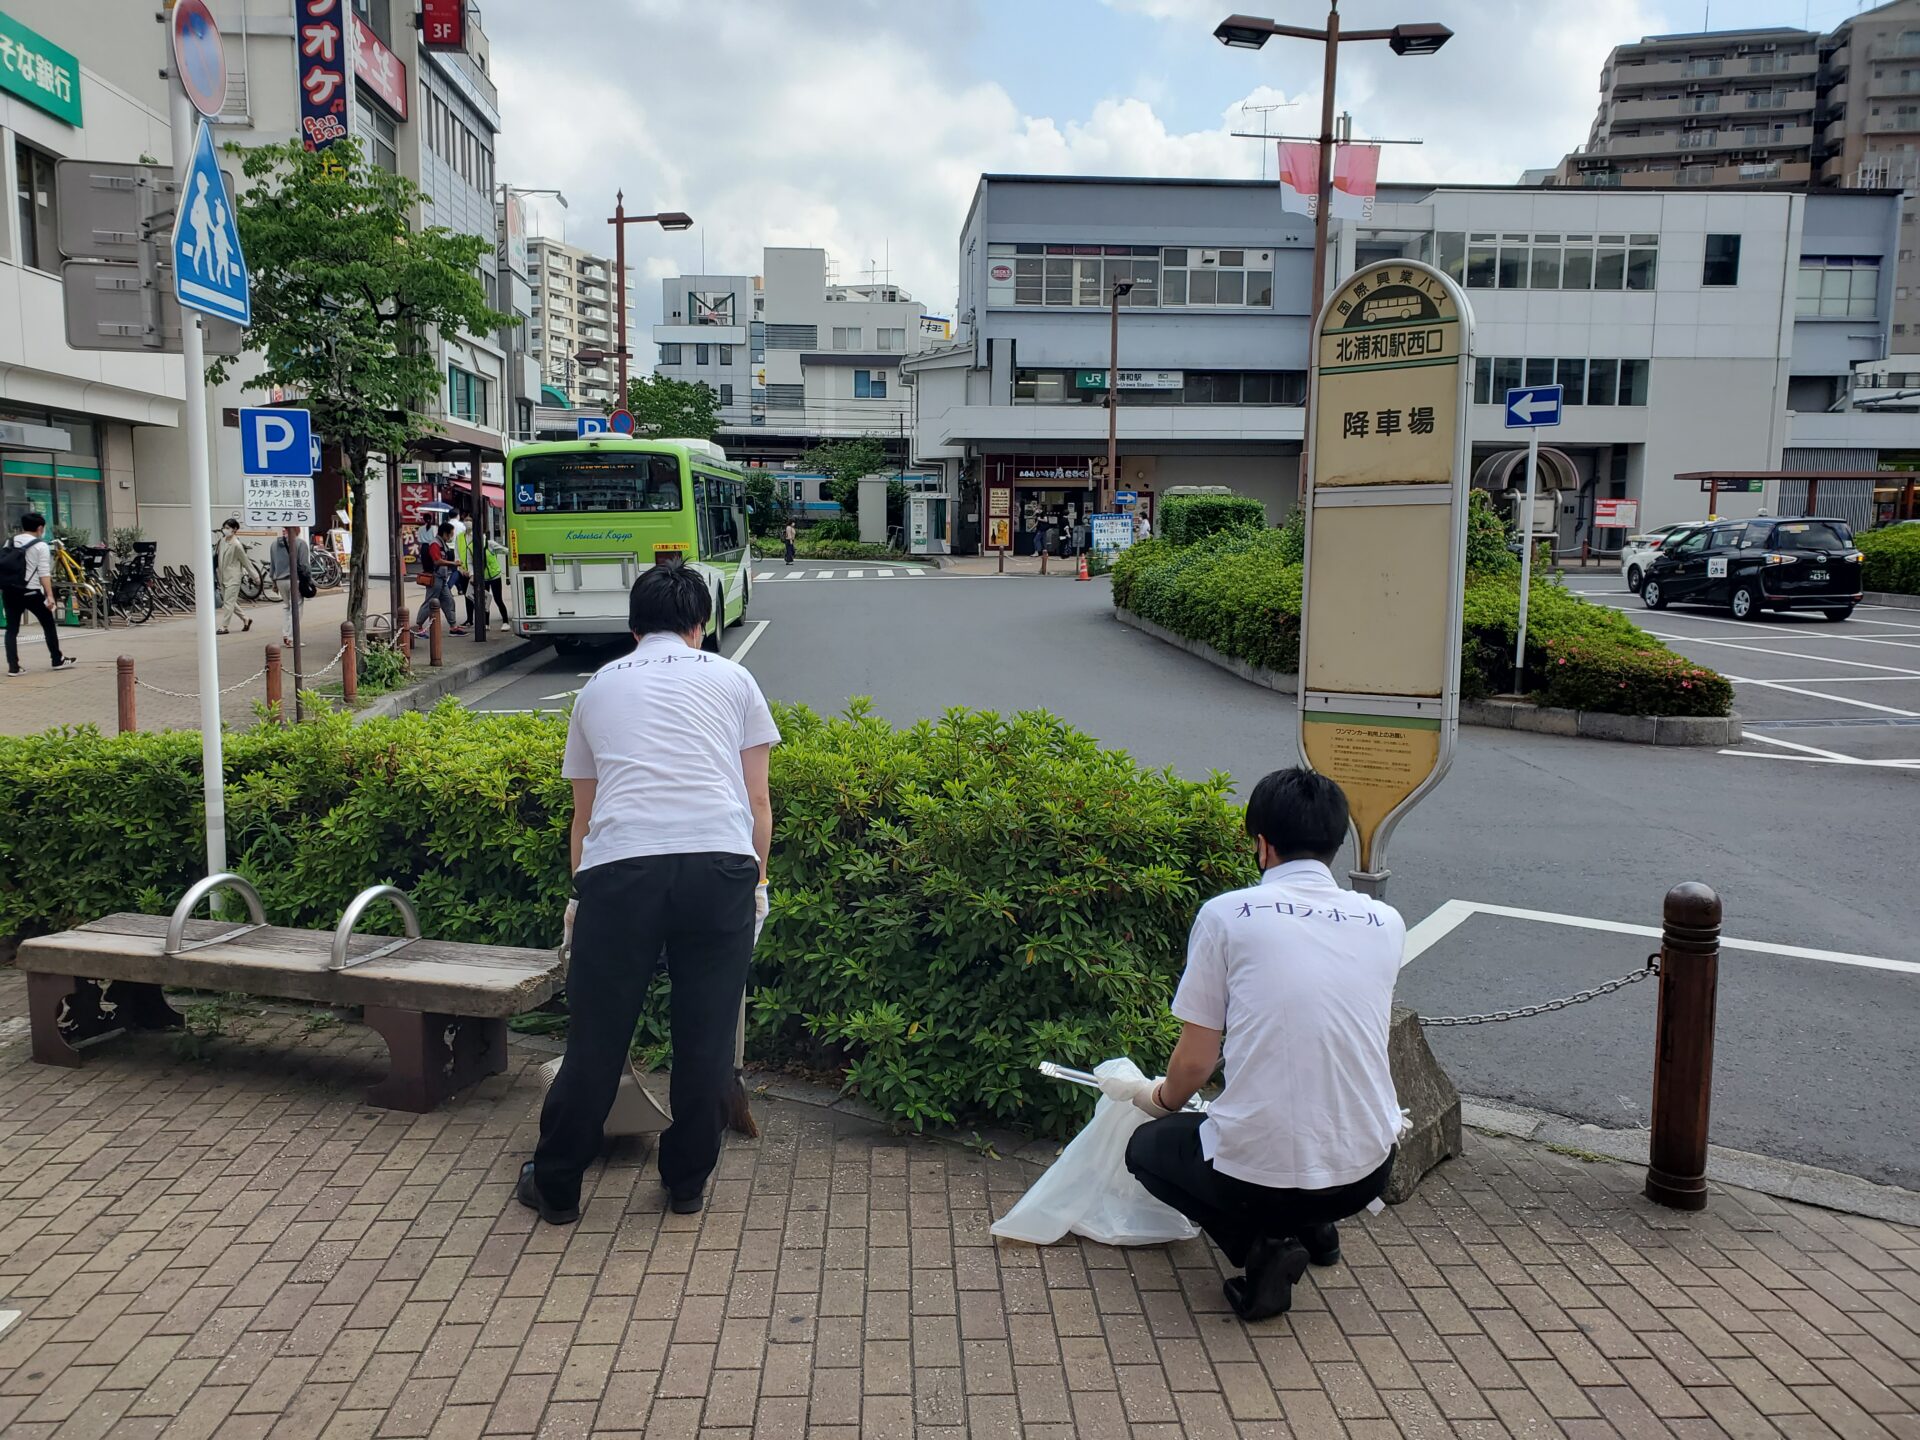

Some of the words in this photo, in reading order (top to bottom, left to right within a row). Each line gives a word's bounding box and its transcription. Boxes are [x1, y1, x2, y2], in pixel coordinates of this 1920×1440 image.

[433, 23, 452, 38] 3F
[0, 33, 71, 103] そな銀行
[303, 115, 338, 133] Ban
[311, 125, 346, 144] Ban
[1337, 269, 1448, 316] 国際興業バス
[1336, 329, 1443, 362] 北浦和駅西口
[1085, 373, 1101, 383] JR
[1116, 373, 1142, 381] 浦和駅
[1343, 407, 1435, 439] 降車場
[255, 416, 295, 468] P
[250, 479, 306, 489] 駐車標示枠内
[249, 489, 309, 498] ワクチン接種の
[251, 511, 308, 521] ここから
[565, 529, 603, 541] Kokusai
[605, 529, 633, 543] Kogyo
[1235, 902, 1385, 927] オーロラ・ホール
